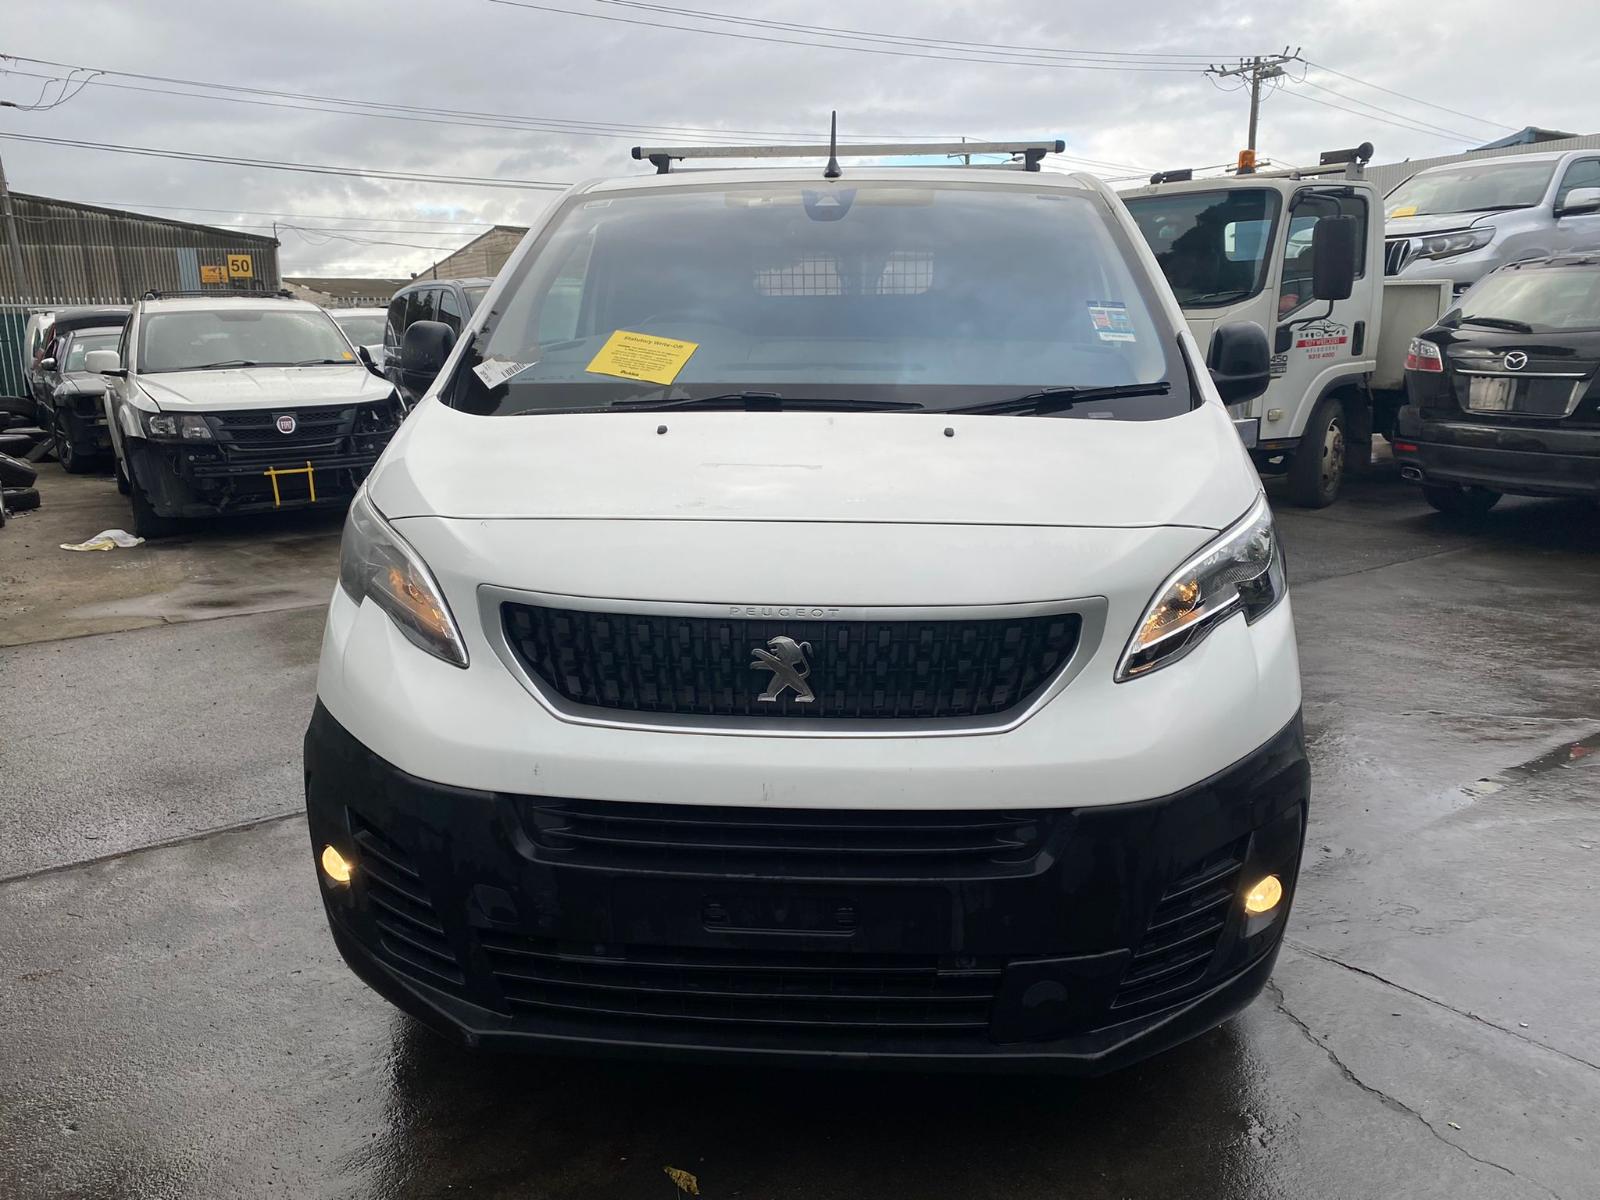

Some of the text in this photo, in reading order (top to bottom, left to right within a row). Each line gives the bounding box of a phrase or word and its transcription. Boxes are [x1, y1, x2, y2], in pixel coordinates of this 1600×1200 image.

[231, 259, 250, 272] 50
[624, 336, 684, 349] Statutory Write-Off
[1270, 354, 1288, 362] 450
[280, 420, 292, 430] FIAT
[729, 606, 840, 617] PEUGEOT
